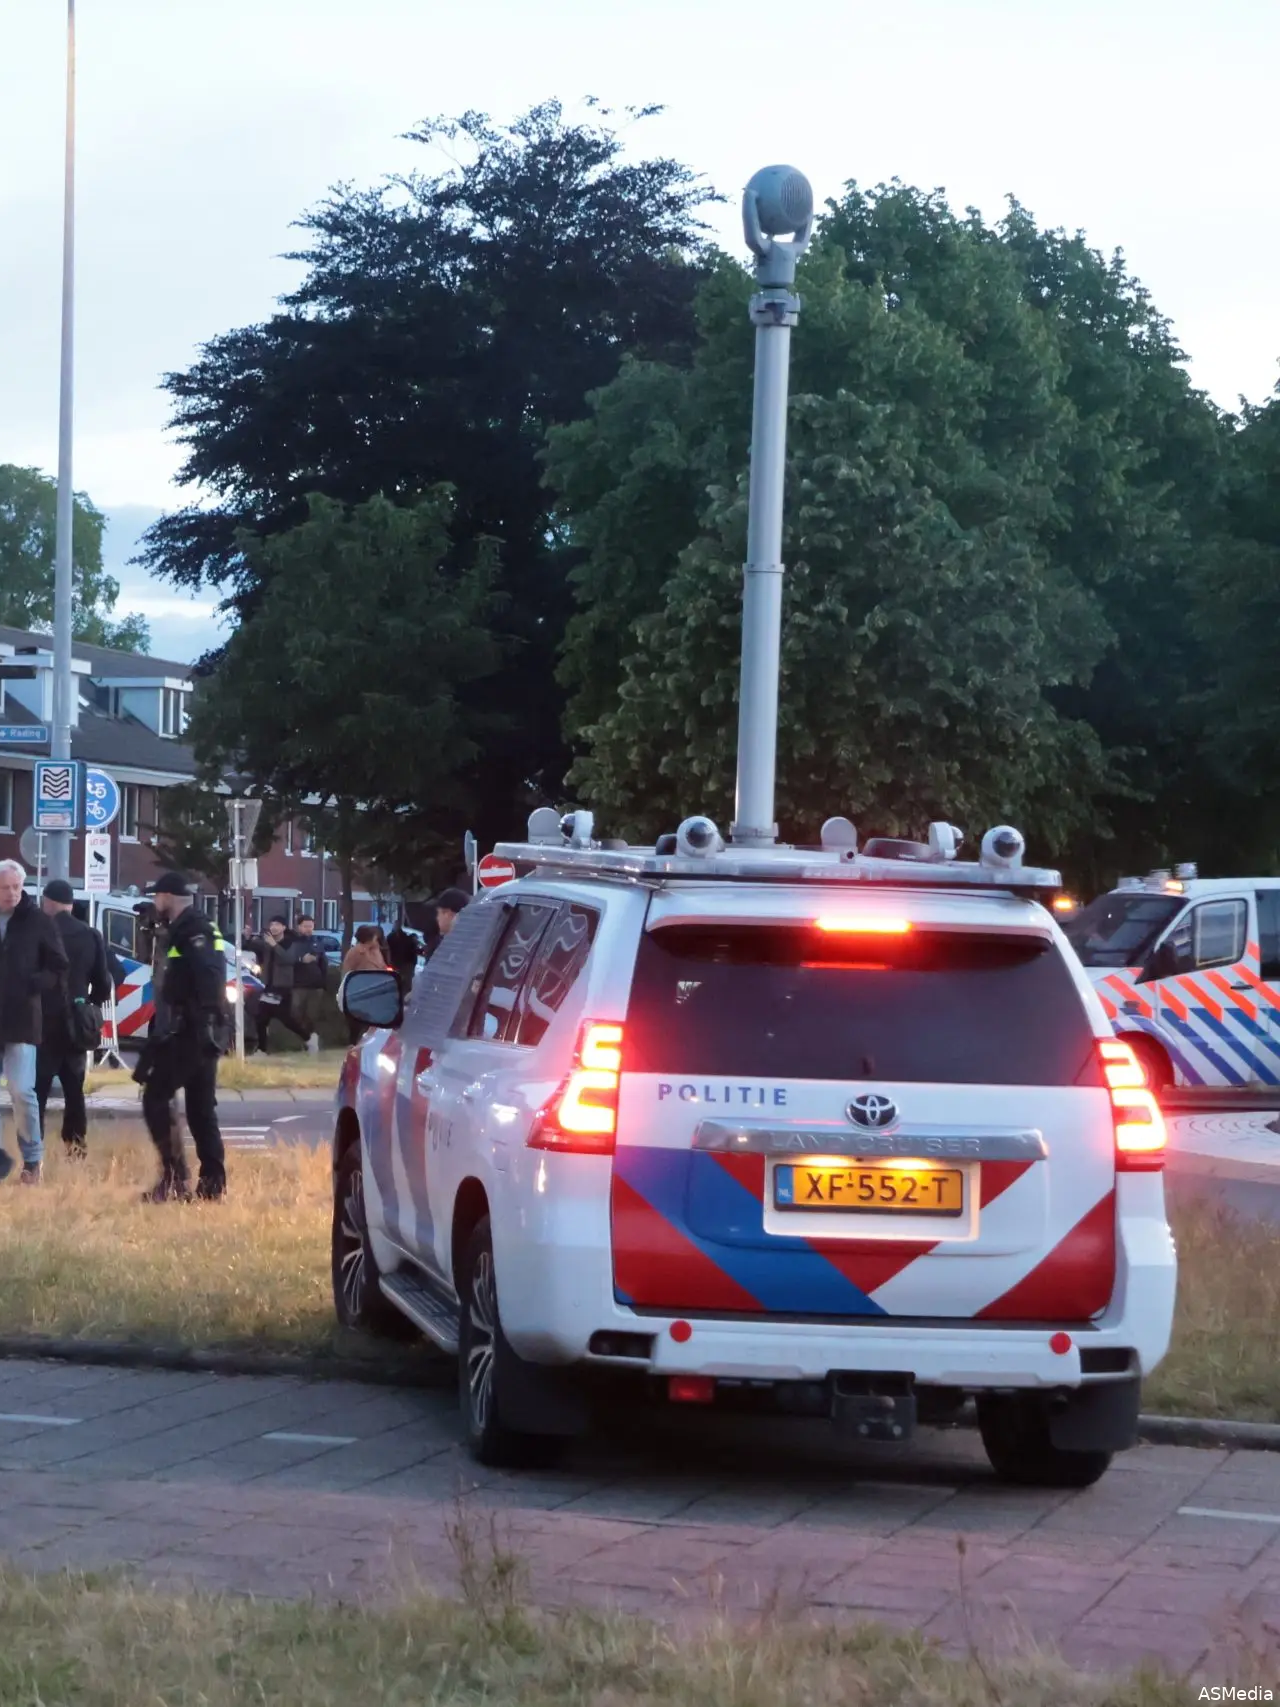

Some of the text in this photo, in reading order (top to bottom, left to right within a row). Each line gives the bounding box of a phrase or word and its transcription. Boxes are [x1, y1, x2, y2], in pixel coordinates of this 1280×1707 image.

[658, 1083, 788, 1106] POLITIE
[771, 1132, 982, 1153] LAND CRUSER
[805, 1171, 950, 1204] XF-552-T
